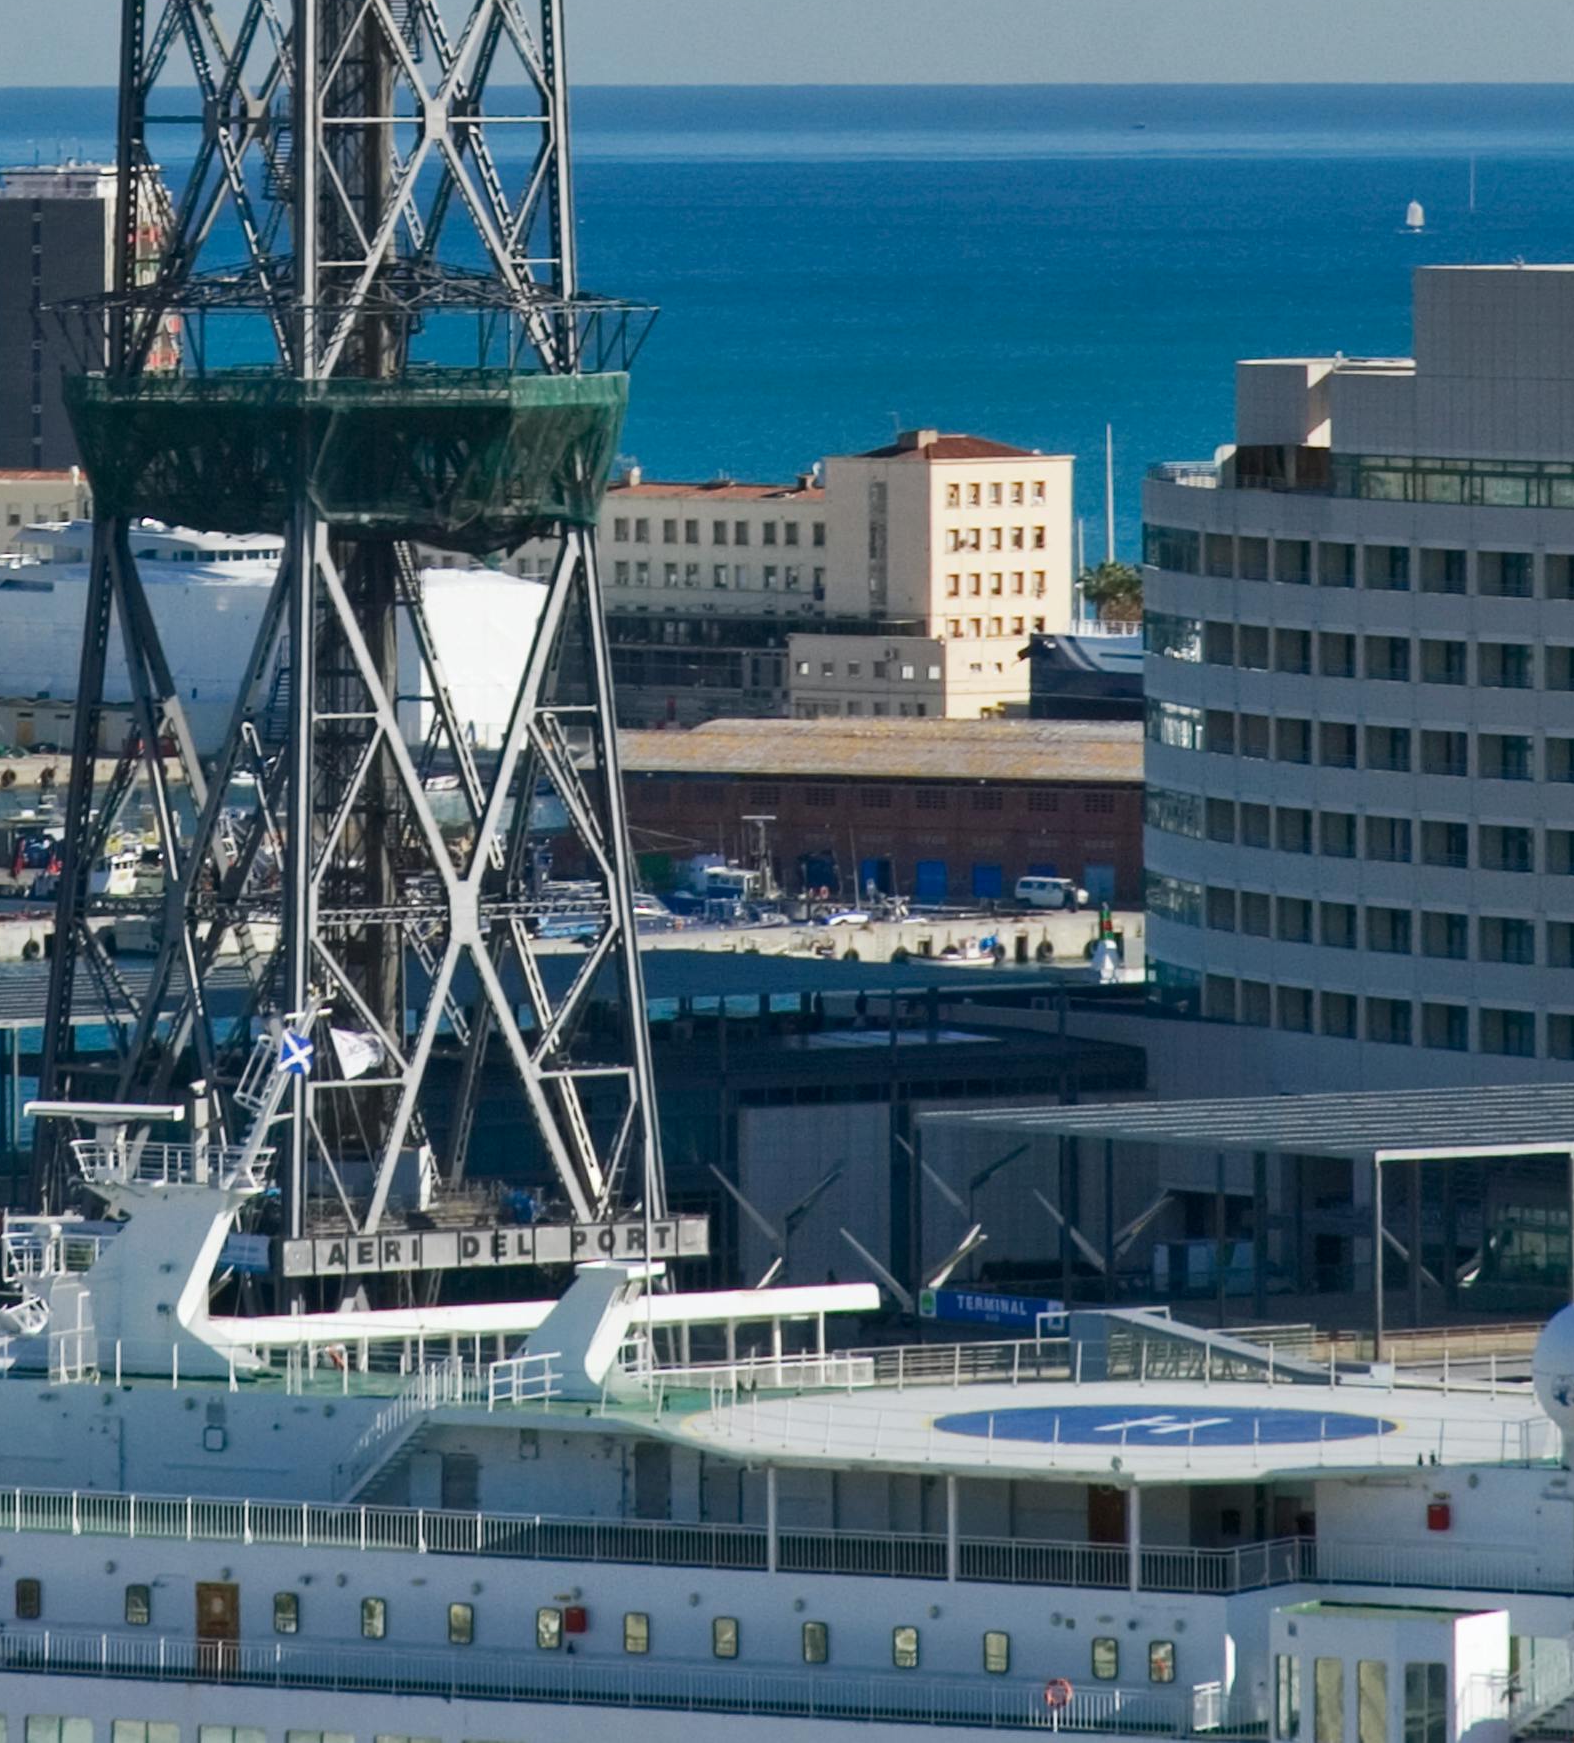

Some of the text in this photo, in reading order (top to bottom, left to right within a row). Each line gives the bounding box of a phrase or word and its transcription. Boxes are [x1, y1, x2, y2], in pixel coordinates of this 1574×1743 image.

[327, 1226, 671, 1266] AERI DEL PORT
[956, 1294, 1027, 1316] TERMINAL
